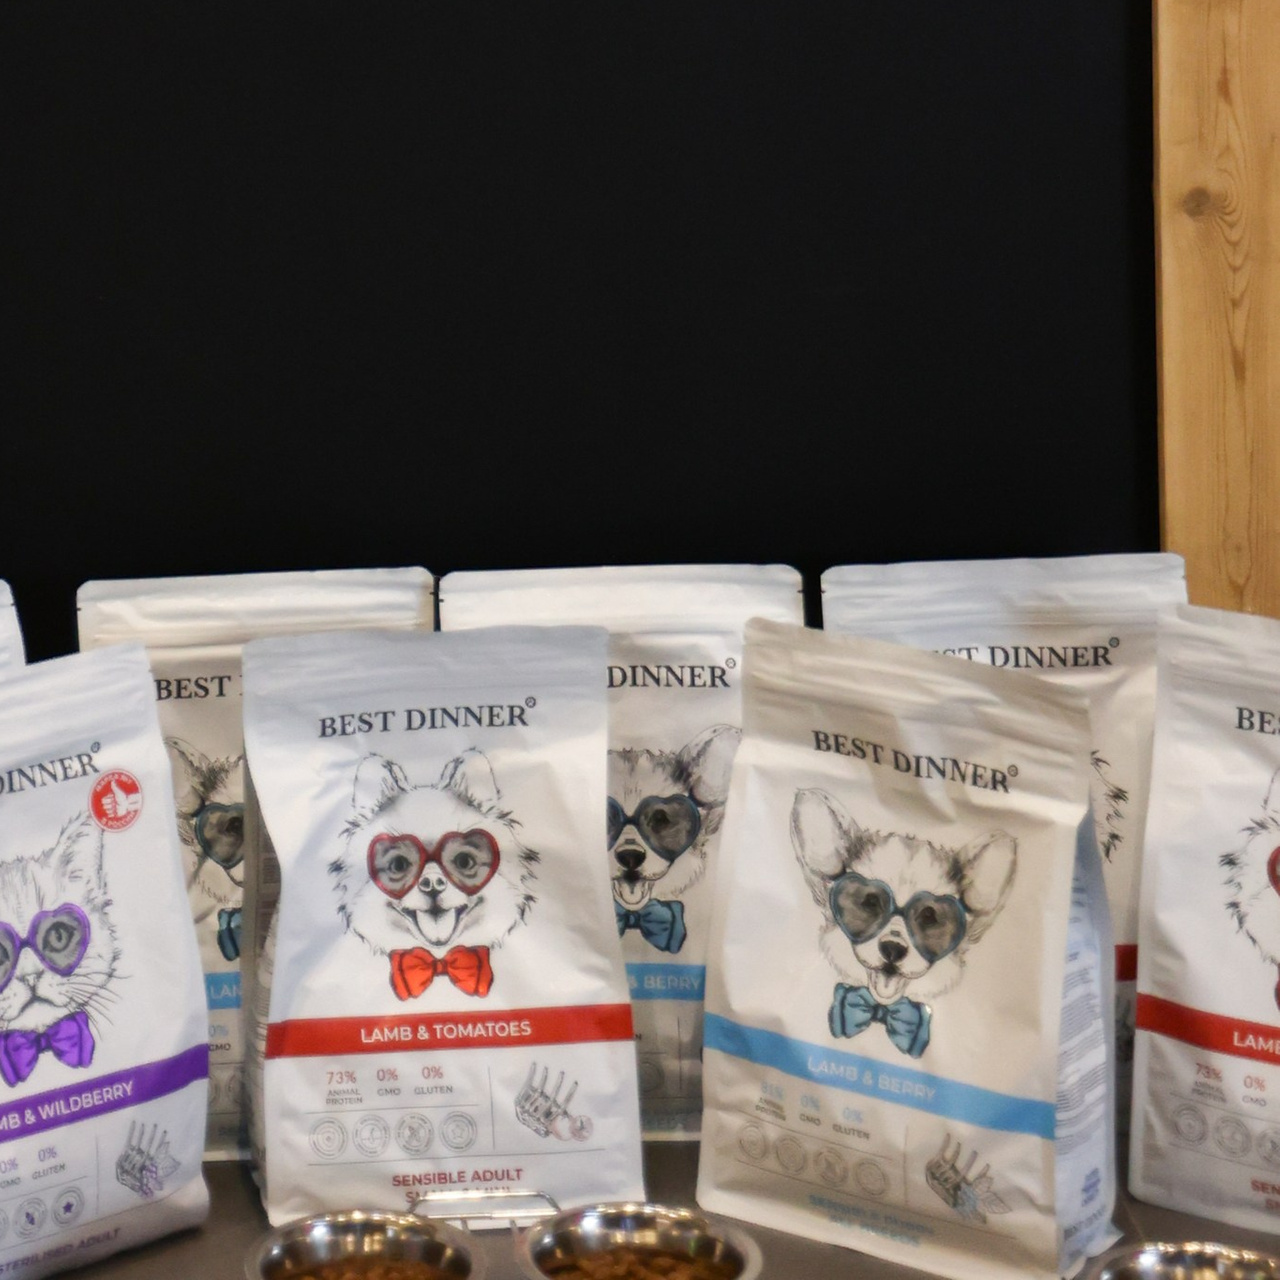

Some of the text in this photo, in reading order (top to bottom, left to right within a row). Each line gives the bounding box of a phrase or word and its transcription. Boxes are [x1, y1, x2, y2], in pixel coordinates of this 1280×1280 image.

[988, 646, 1111, 668] DINNER
[607, 665, 730, 688] DINNER
[155, 676, 231, 701] BEST
[320, 704, 529, 738] BEST DINNER
[812, 731, 1009, 793] BEST DINNER
[644, 976, 701, 989] BERRY
[361, 1021, 532, 1043] LAMB & TOMATOES
[326, 1066, 443, 1085] 73% 0% 0%
[808, 1057, 936, 1100] LAMB & BERRY
[1244, 1075, 1265, 1091] 0%
[326, 1097, 363, 1105] PROTEIN
[377, 1088, 400, 1096] GMO
[414, 1085, 453, 1095] GLUTEN
[24, 1110, 36, 1124] &
[38, 1080, 134, 1119] WILDBERRY
[801, 1094, 820, 1110] 0%
[843, 1107, 863, 1123] 0%
[0, 1158, 18, 1174] 0%
[38, 1147, 57, 1162] 0%
[0, 1177, 21, 1189] GMO
[32, 1164, 66, 1179] GLUTEN
[392, 1168, 523, 1187] SENSIBLE ADULT
[78, 1228, 120, 1248] ADULT
